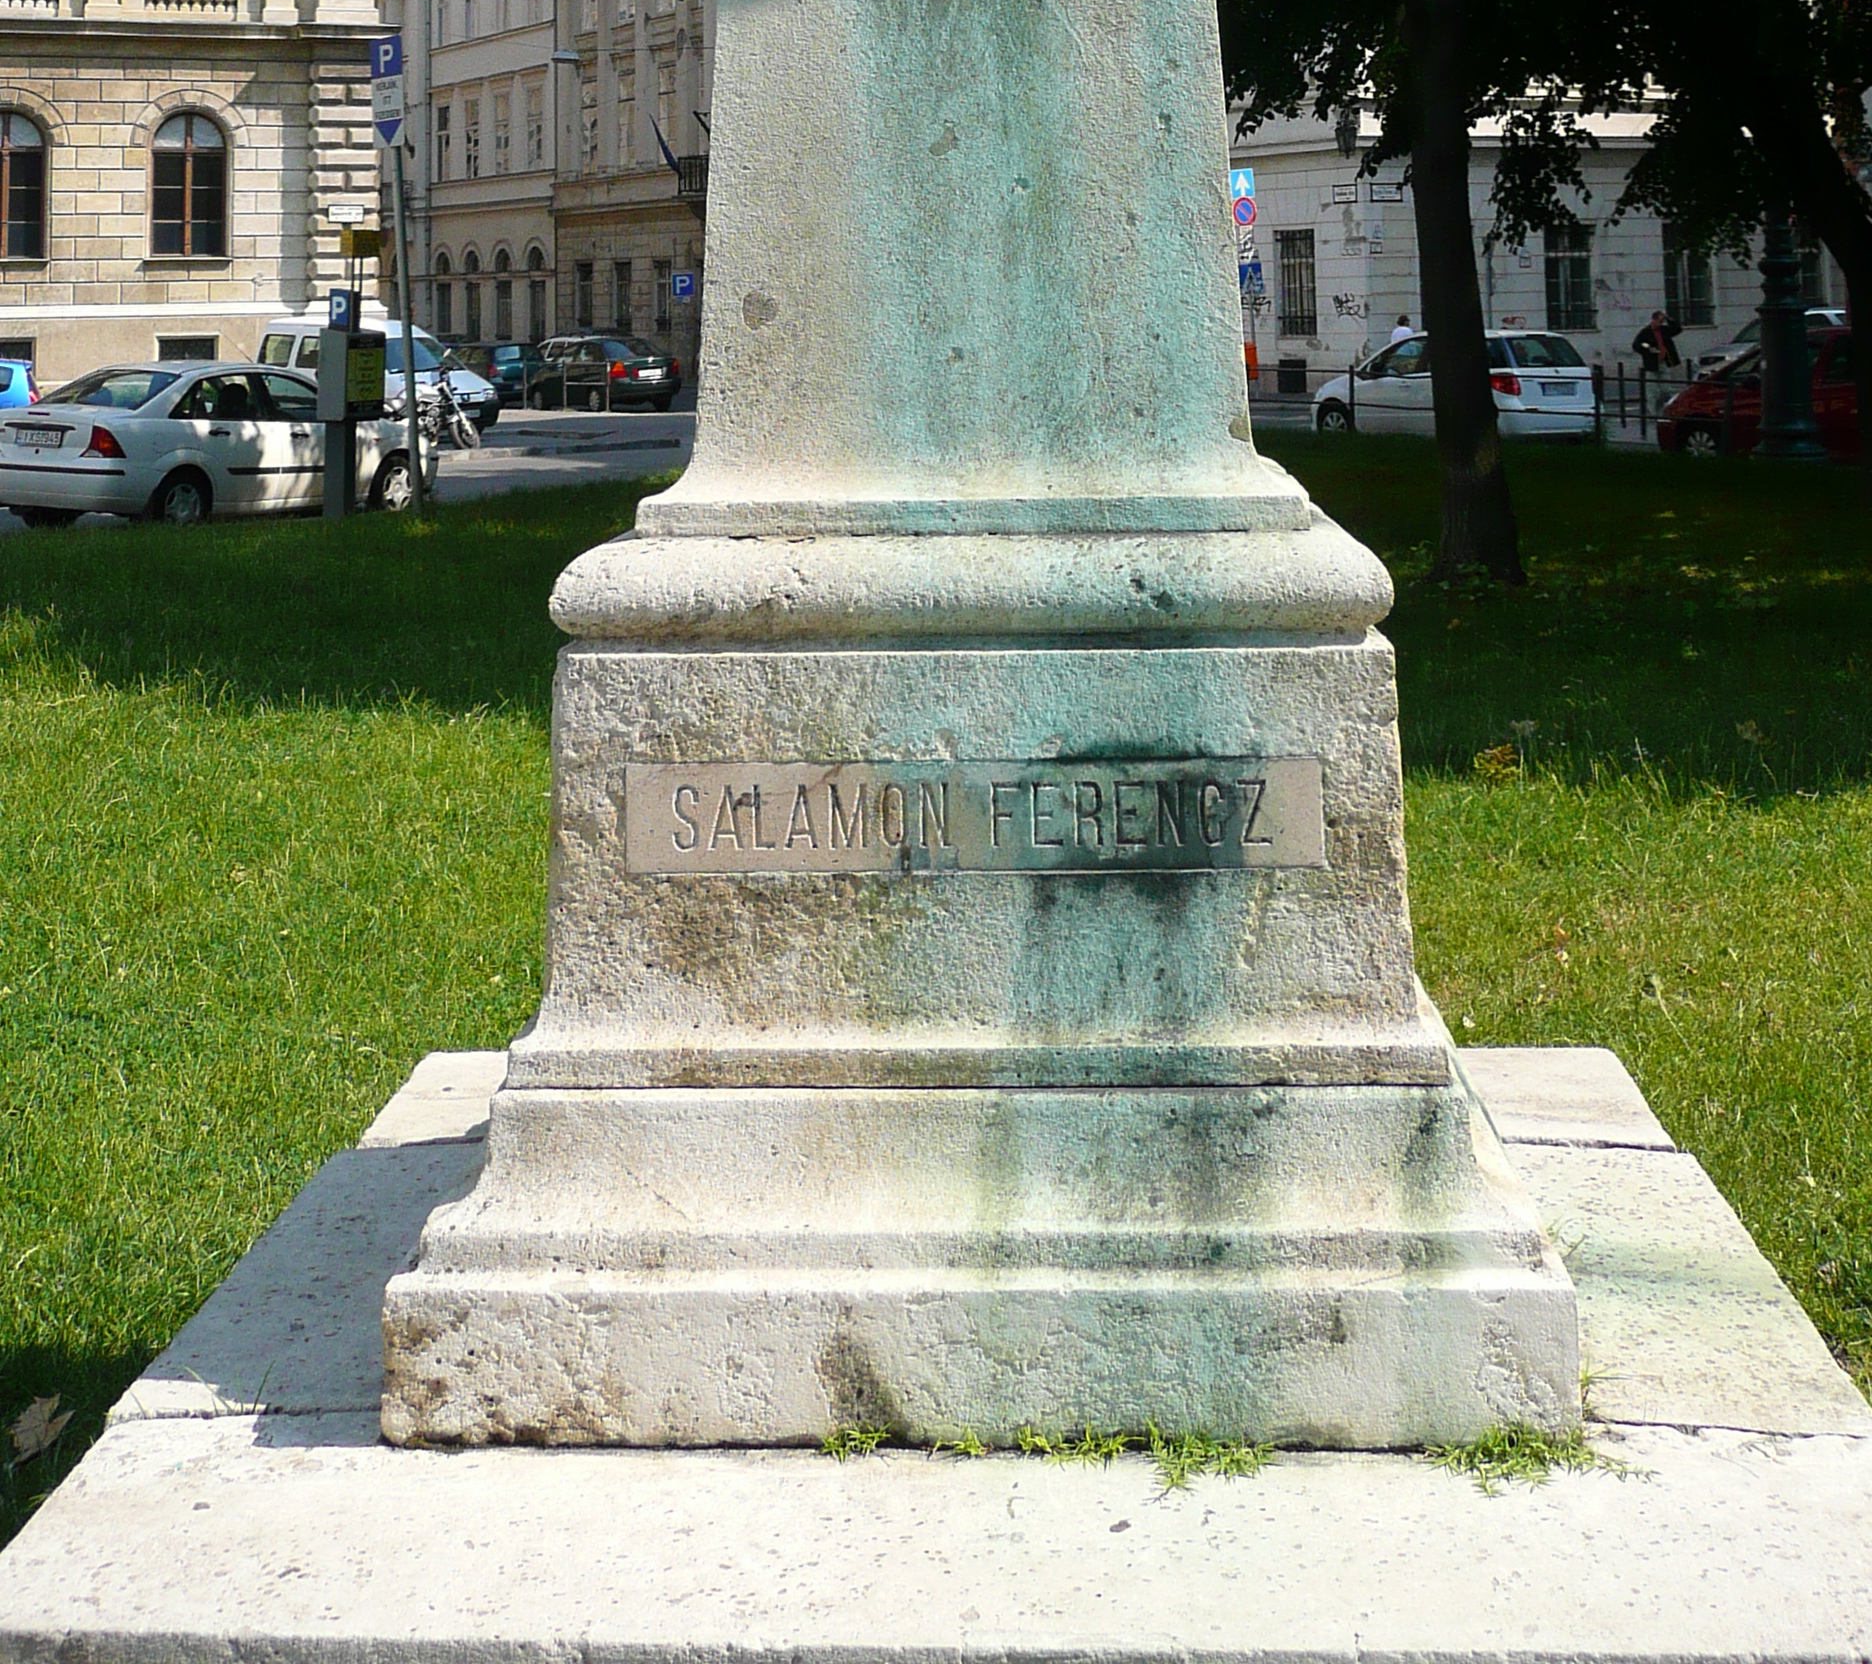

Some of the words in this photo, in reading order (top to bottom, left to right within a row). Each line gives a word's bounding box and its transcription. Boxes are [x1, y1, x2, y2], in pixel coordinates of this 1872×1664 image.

[379, 44, 394, 74] P
[331, 296, 347, 321] P
[671, 782, 953, 853] SALAMON
[990, 779, 1274, 848] FERENCZ
